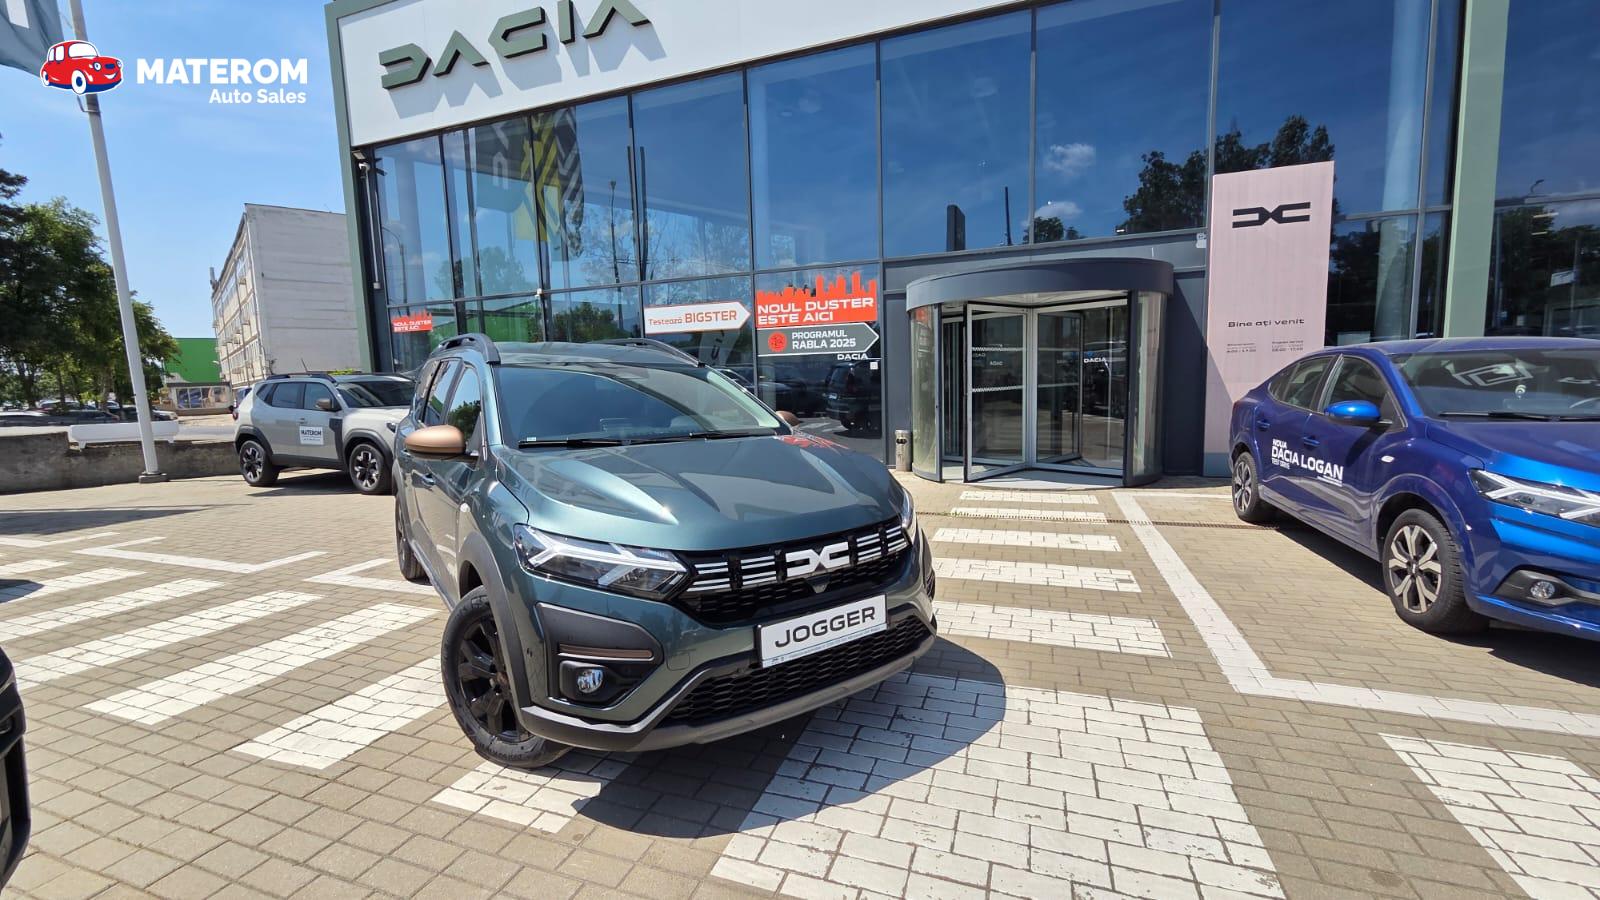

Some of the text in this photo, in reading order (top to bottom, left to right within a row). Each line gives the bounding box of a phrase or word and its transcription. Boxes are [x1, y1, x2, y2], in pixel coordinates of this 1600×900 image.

[378, 0, 652, 90] DACIA
[758, 297, 874, 314] NOUL DUSTER
[685, 310, 737, 323] BIGSTER
[758, 311, 833, 325] ESTE AICI
[791, 329, 847, 339] PROGRAMUL
[792, 338, 856, 349] RABLA 2025
[837, 353, 868, 361] DACIA
[1271, 446, 1344, 480] DACIA LOGAN
[775, 606, 876, 648] JOGGER
